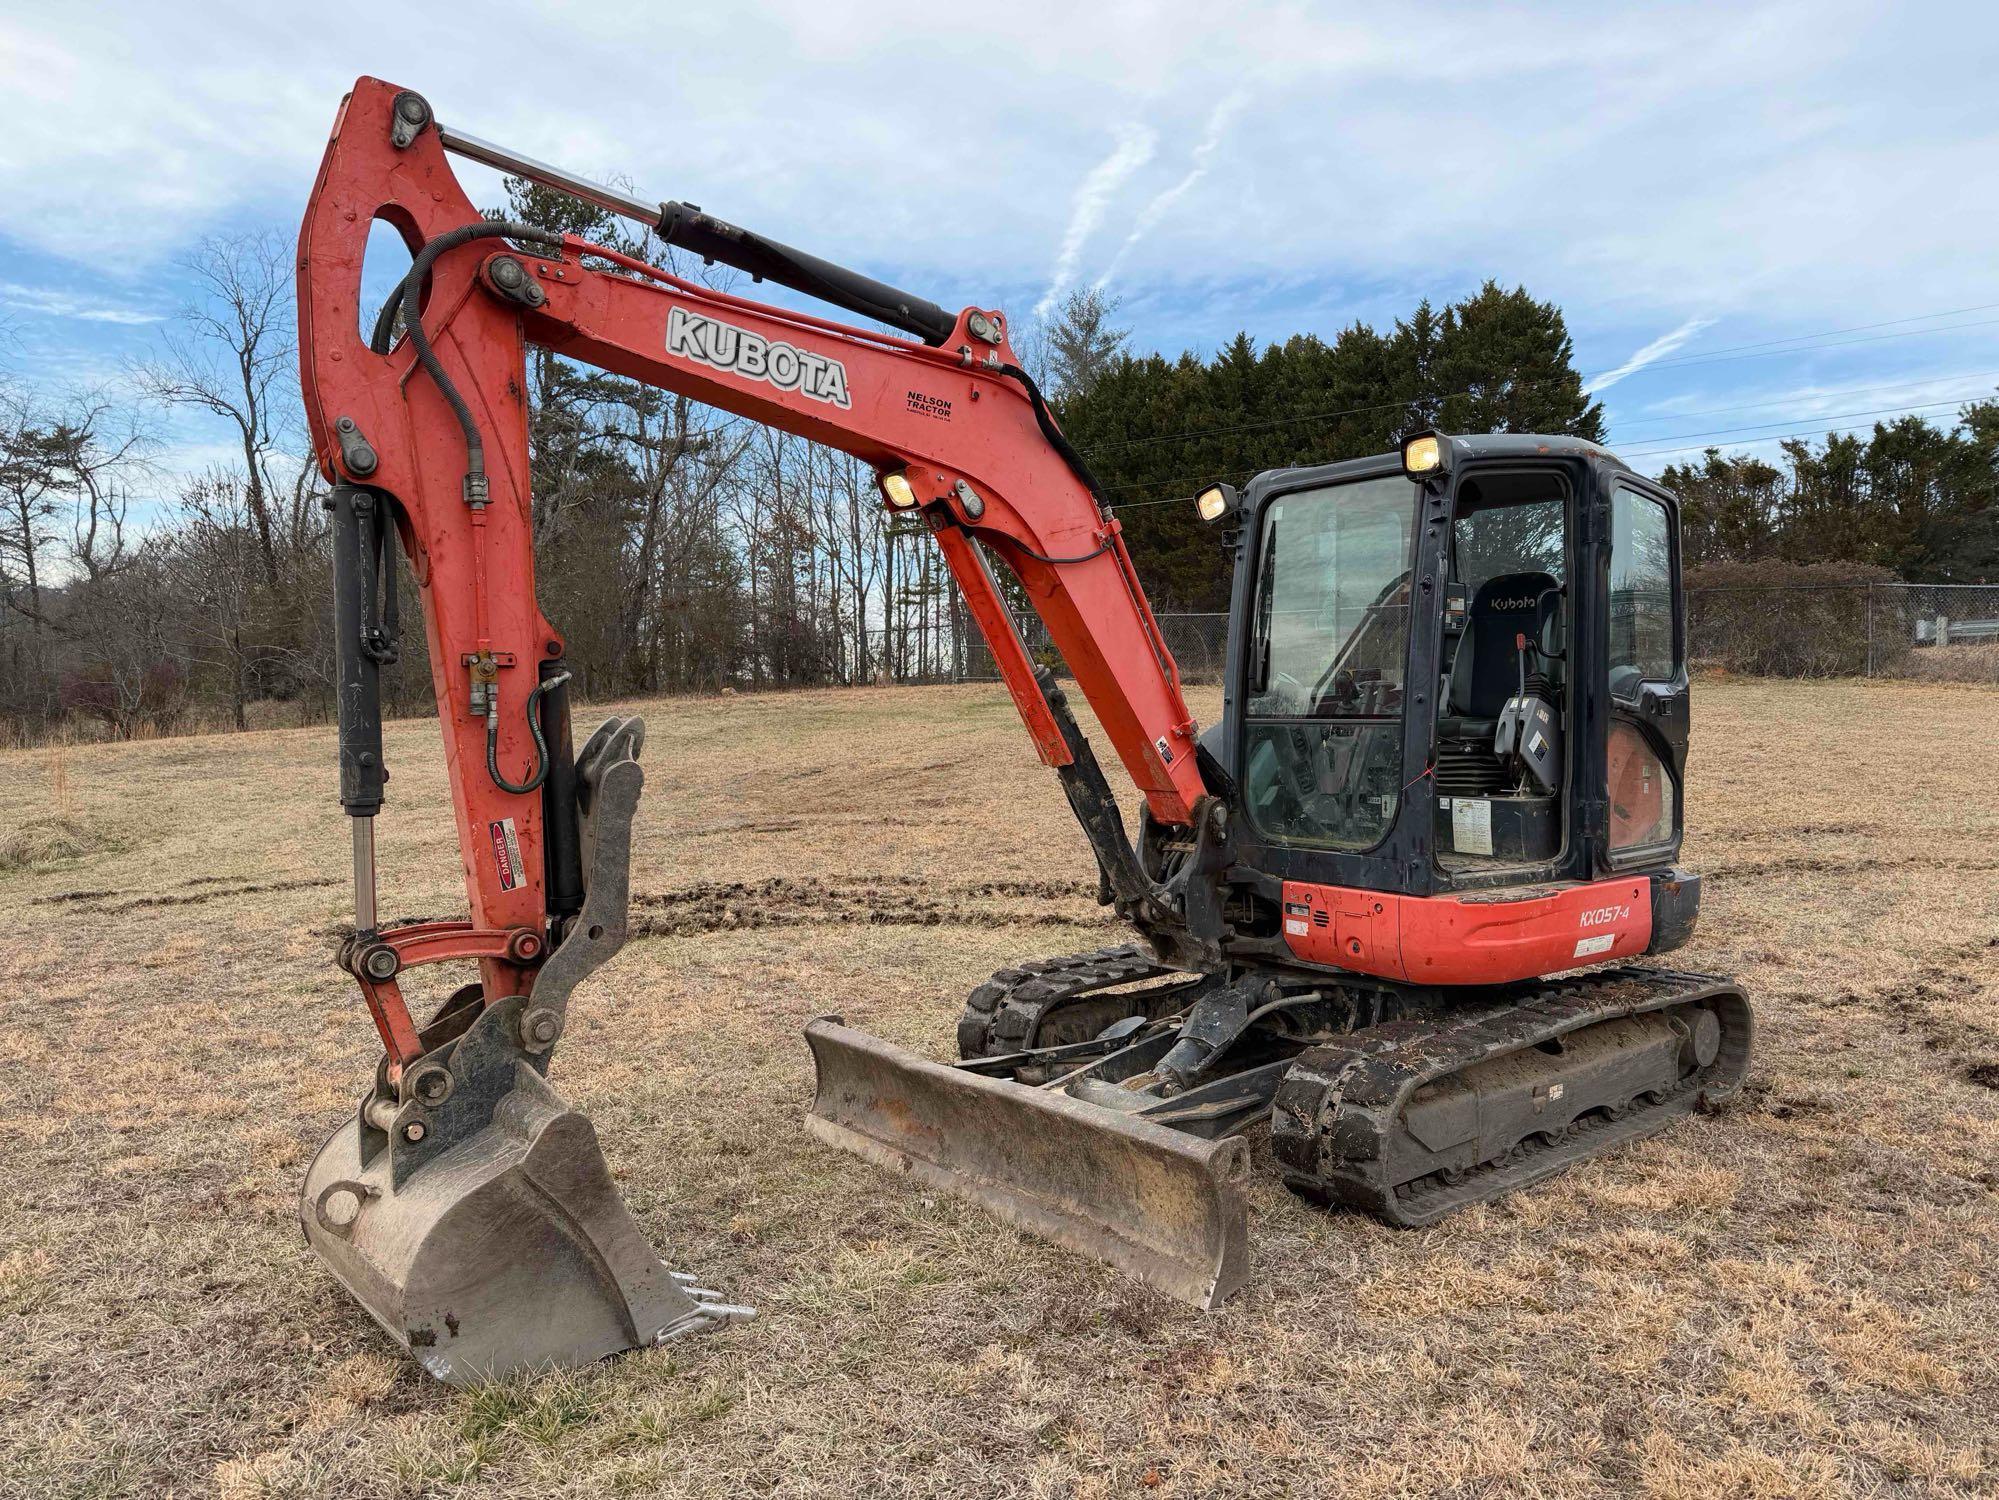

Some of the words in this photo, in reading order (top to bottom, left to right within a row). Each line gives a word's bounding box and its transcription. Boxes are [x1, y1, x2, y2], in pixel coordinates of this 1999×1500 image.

[668, 309, 849, 405] KUBOTA
[907, 391, 951, 409] NELSON
[907, 400, 951, 417] TRACTOR
[1491, 596, 1536, 610] Kubota
[496, 837, 510, 875] DANGER
